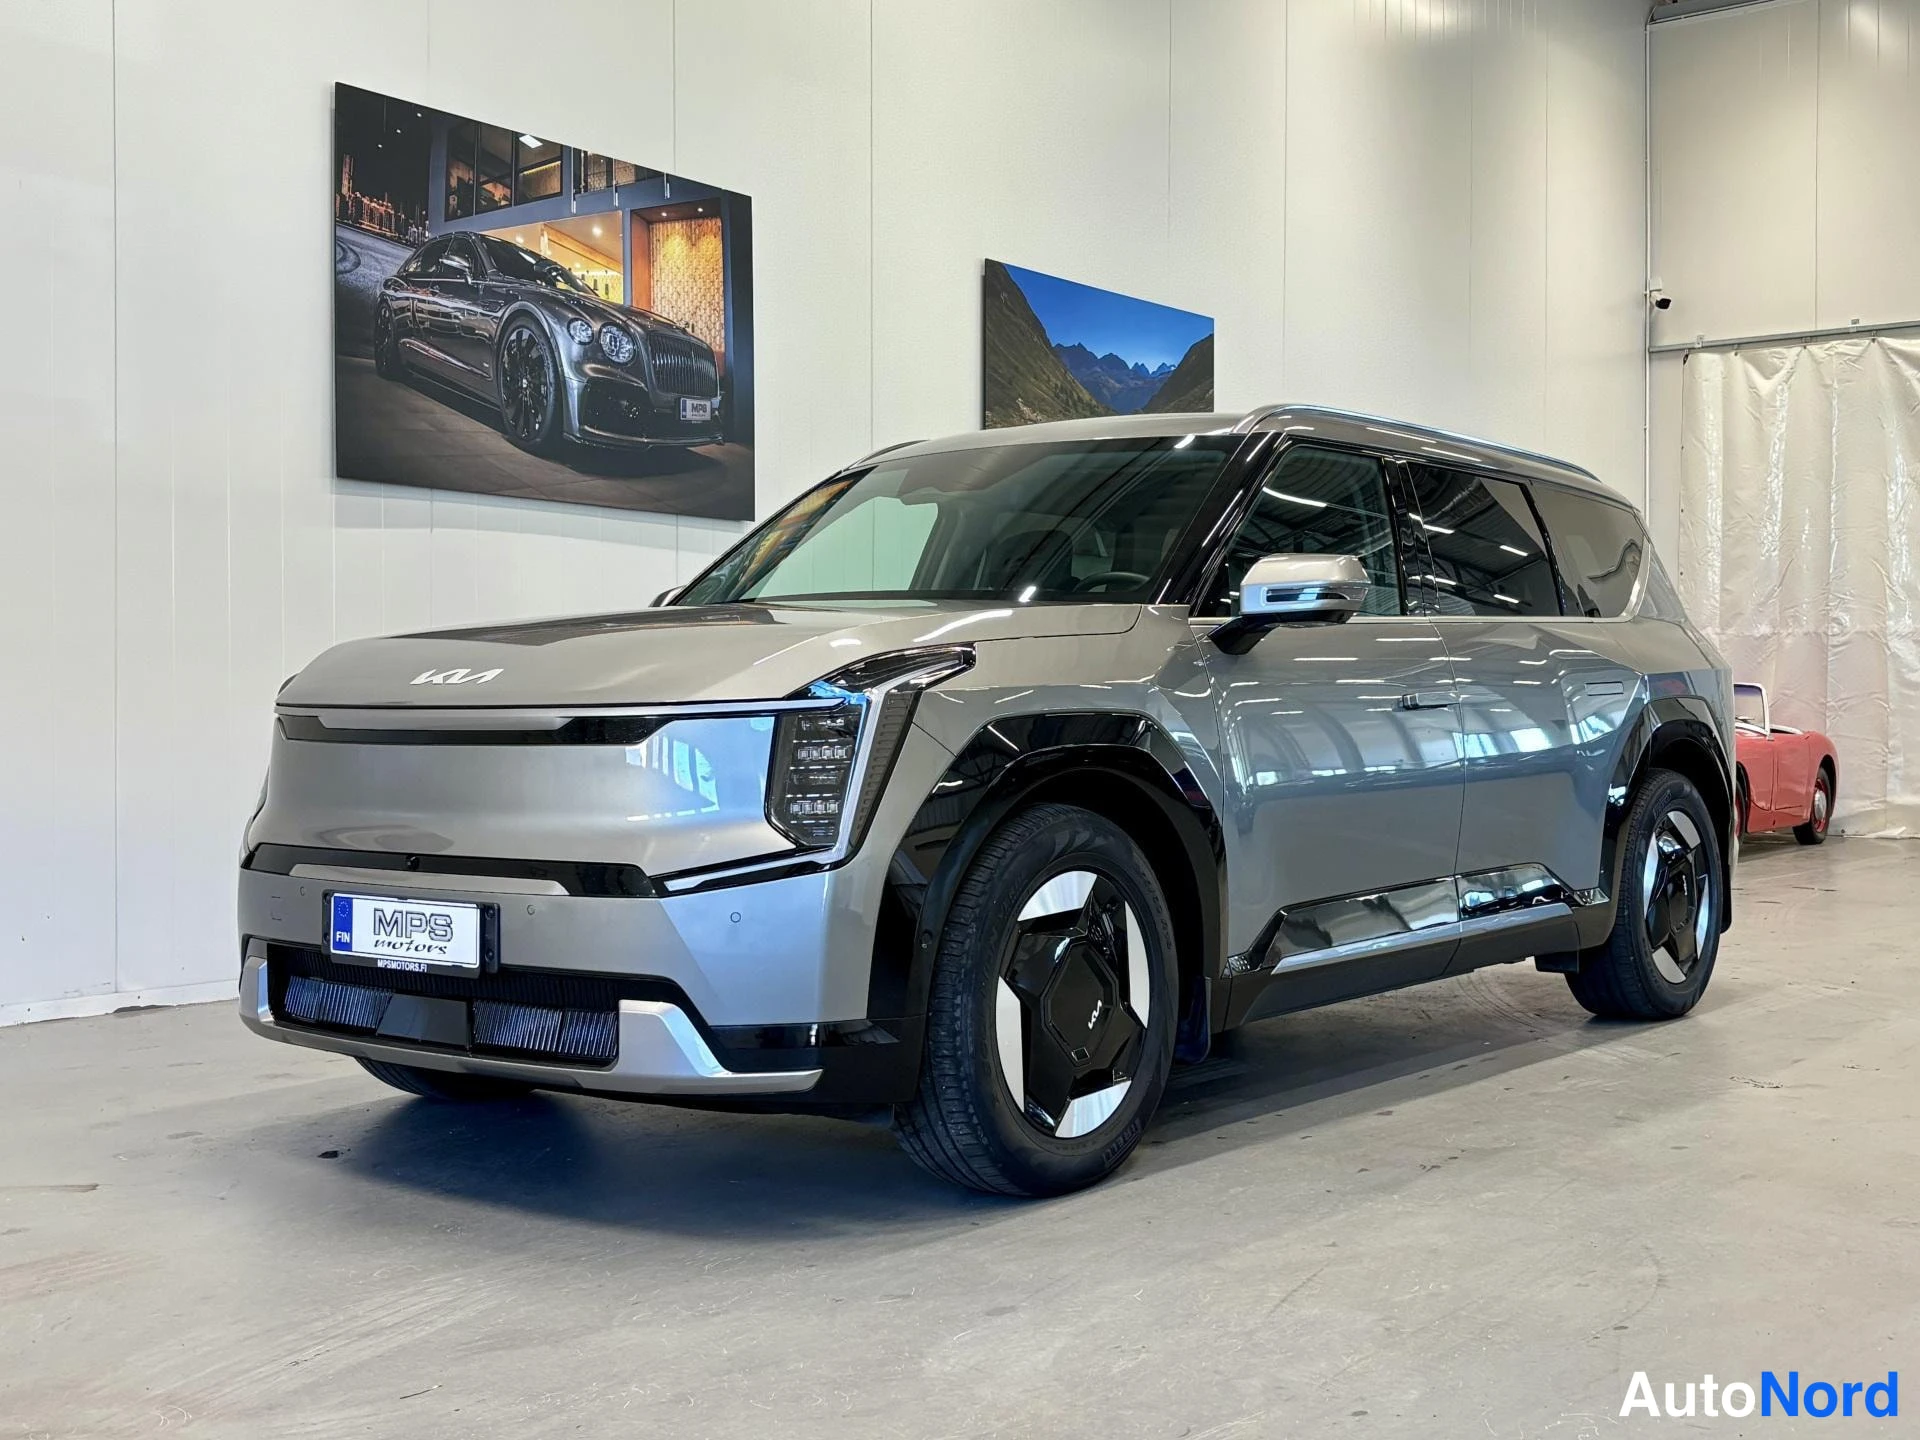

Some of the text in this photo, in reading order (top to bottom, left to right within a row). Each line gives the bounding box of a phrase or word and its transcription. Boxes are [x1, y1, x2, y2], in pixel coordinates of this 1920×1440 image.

[373, 907, 454, 942] MPS
[336, 931, 351, 943] FIN
[374, 939, 448, 955] motors
[377, 959, 428, 973] MPSMOTORS.FI
